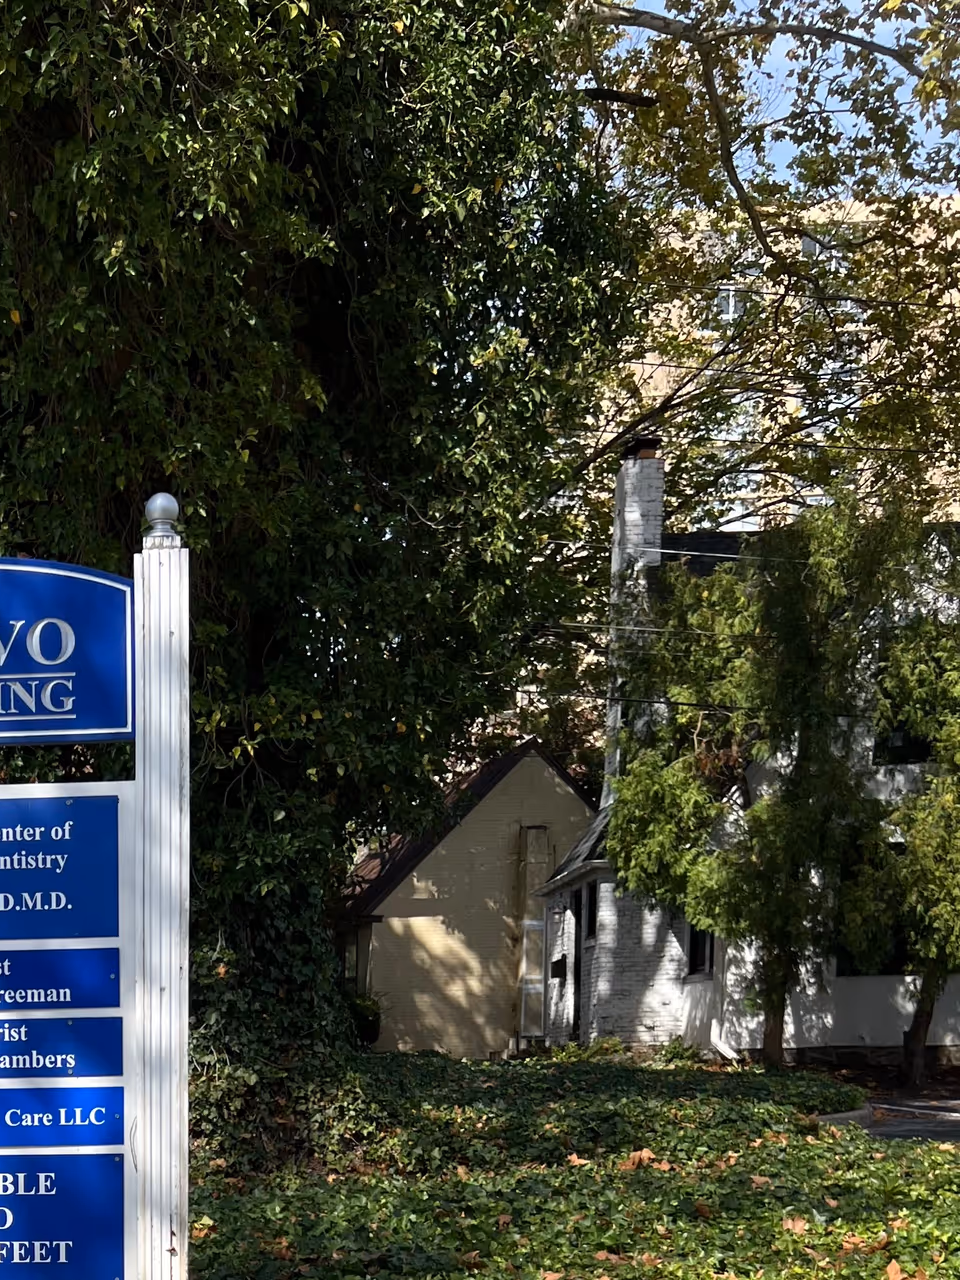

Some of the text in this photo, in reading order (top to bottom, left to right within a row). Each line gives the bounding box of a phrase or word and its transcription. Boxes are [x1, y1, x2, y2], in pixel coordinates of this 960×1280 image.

[51, 821, 73, 839] of
[0, 892, 72, 910] D.M.D.
[5, 1109, 52, 1126] Care
[59, 1108, 105, 1125] LLC
